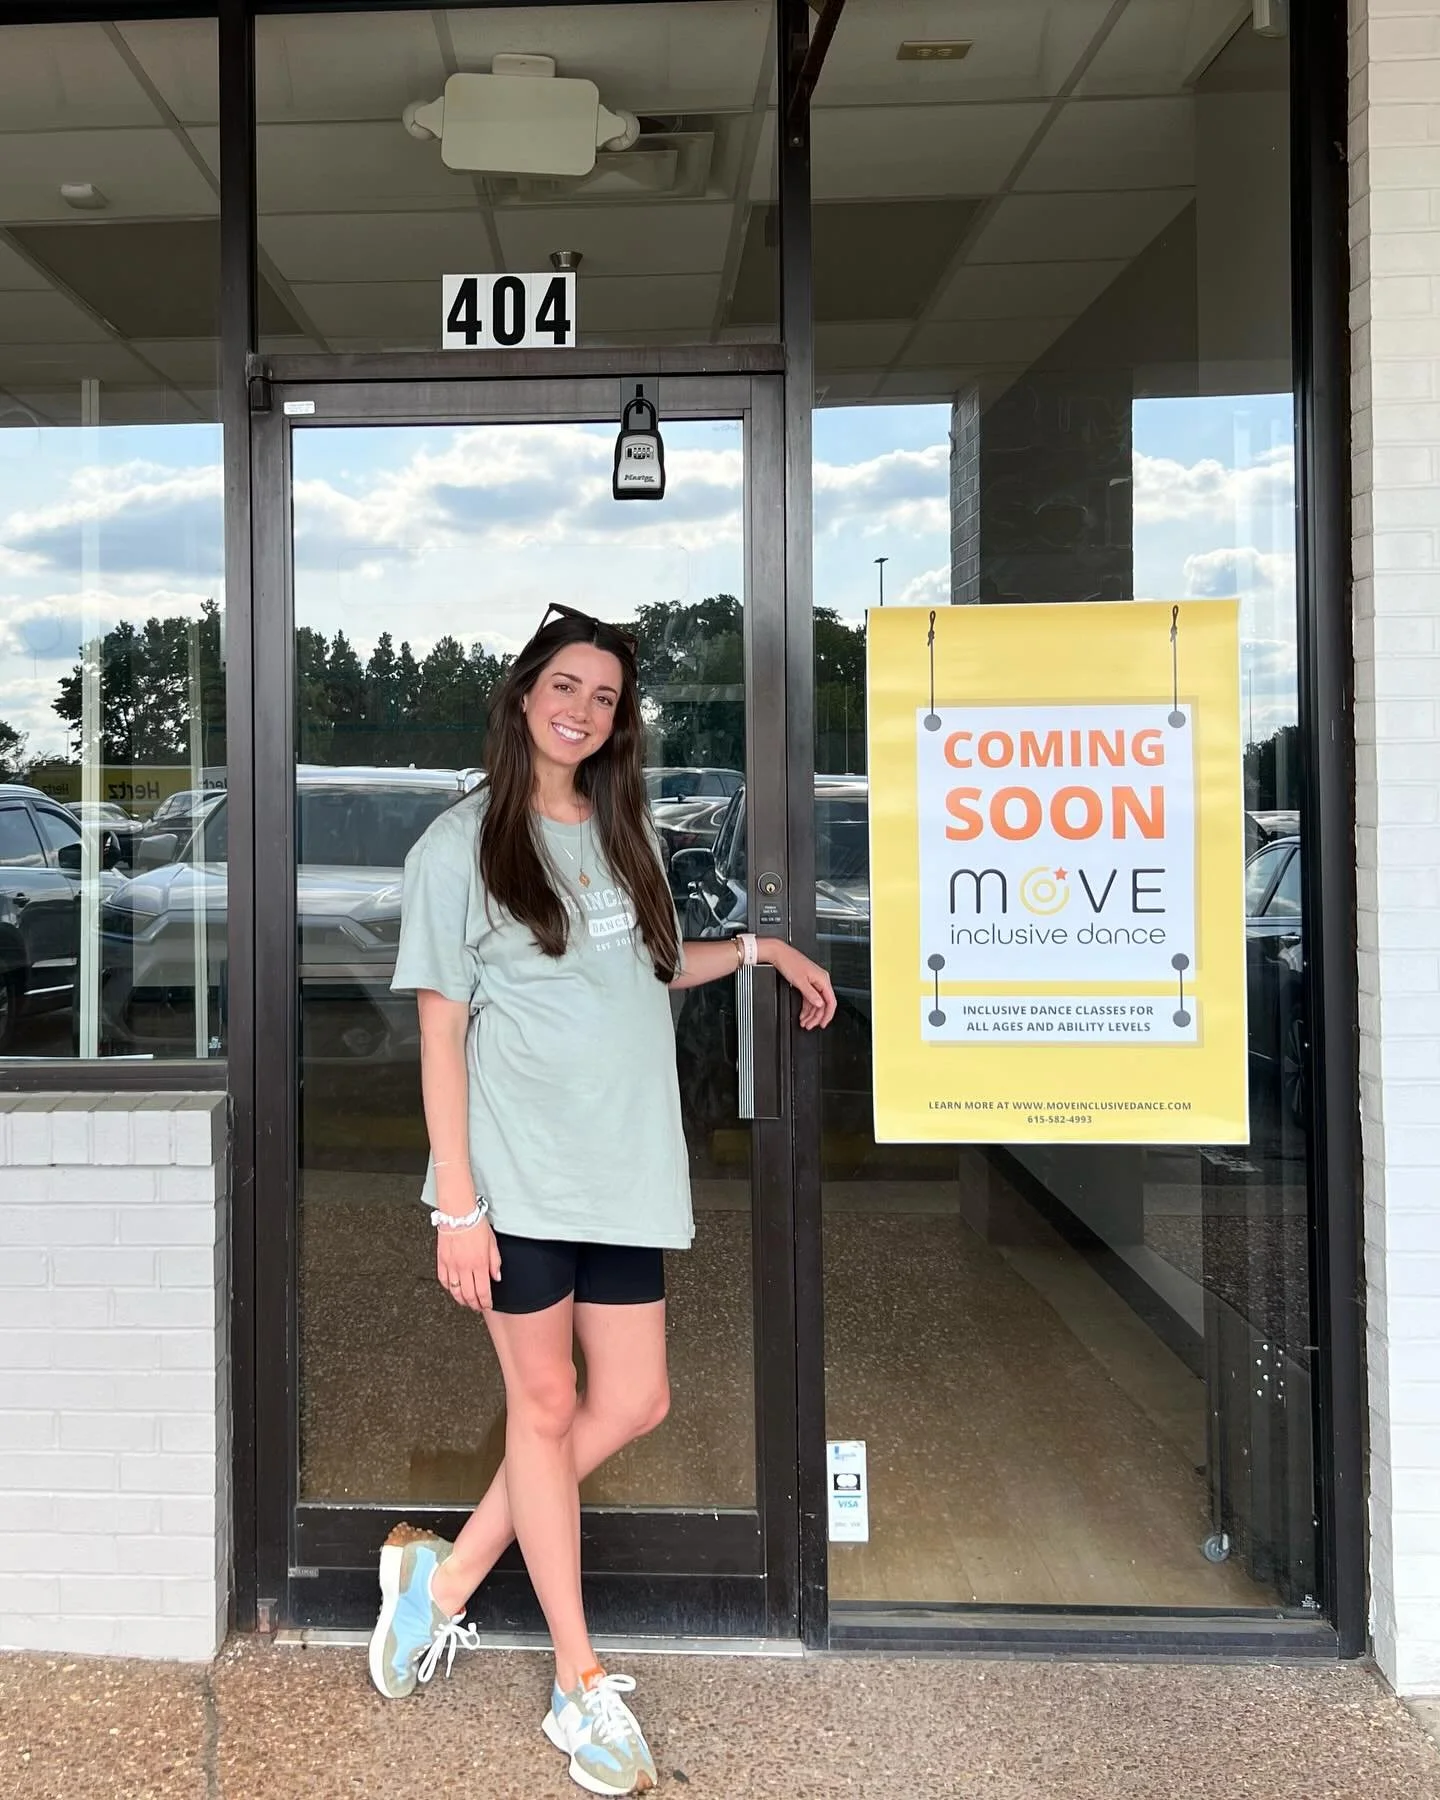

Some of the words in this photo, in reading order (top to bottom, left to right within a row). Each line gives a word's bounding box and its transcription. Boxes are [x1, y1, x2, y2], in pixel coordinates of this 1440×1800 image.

[447, 276, 571, 346] 404
[943, 729, 1165, 768] COMING
[945, 785, 1165, 841] SOON
[950, 923, 1068, 945] inclusive
[1076, 922, 1167, 945] dance
[963, 1005, 1027, 1016] INCLUSIVE
[1030, 1005, 1072, 1016] DANCE
[1076, 1005, 1126, 1016] CLASSES
[1130, 1005, 1154, 1016] FOR
[966, 1022, 989, 1032] ALL
[993, 1022, 1024, 1032] AGES
[1027, 1022, 1054, 1032] AND
[1058, 1022, 1105, 1032] ABILITY
[1108, 1022, 1151, 1032] LEVELS
[928, 1101, 962, 1110] LEARN
[964, 1101, 994, 1110] MORE
[997, 1101, 1010, 1110] AT
[1013, 1101, 1192, 1111] WWW.MOVEINCLUSIVEDANCE.COM
[1027, 1115, 1092, 1124] 615-582-4993
[838, 1499, 859, 1508] VISA
